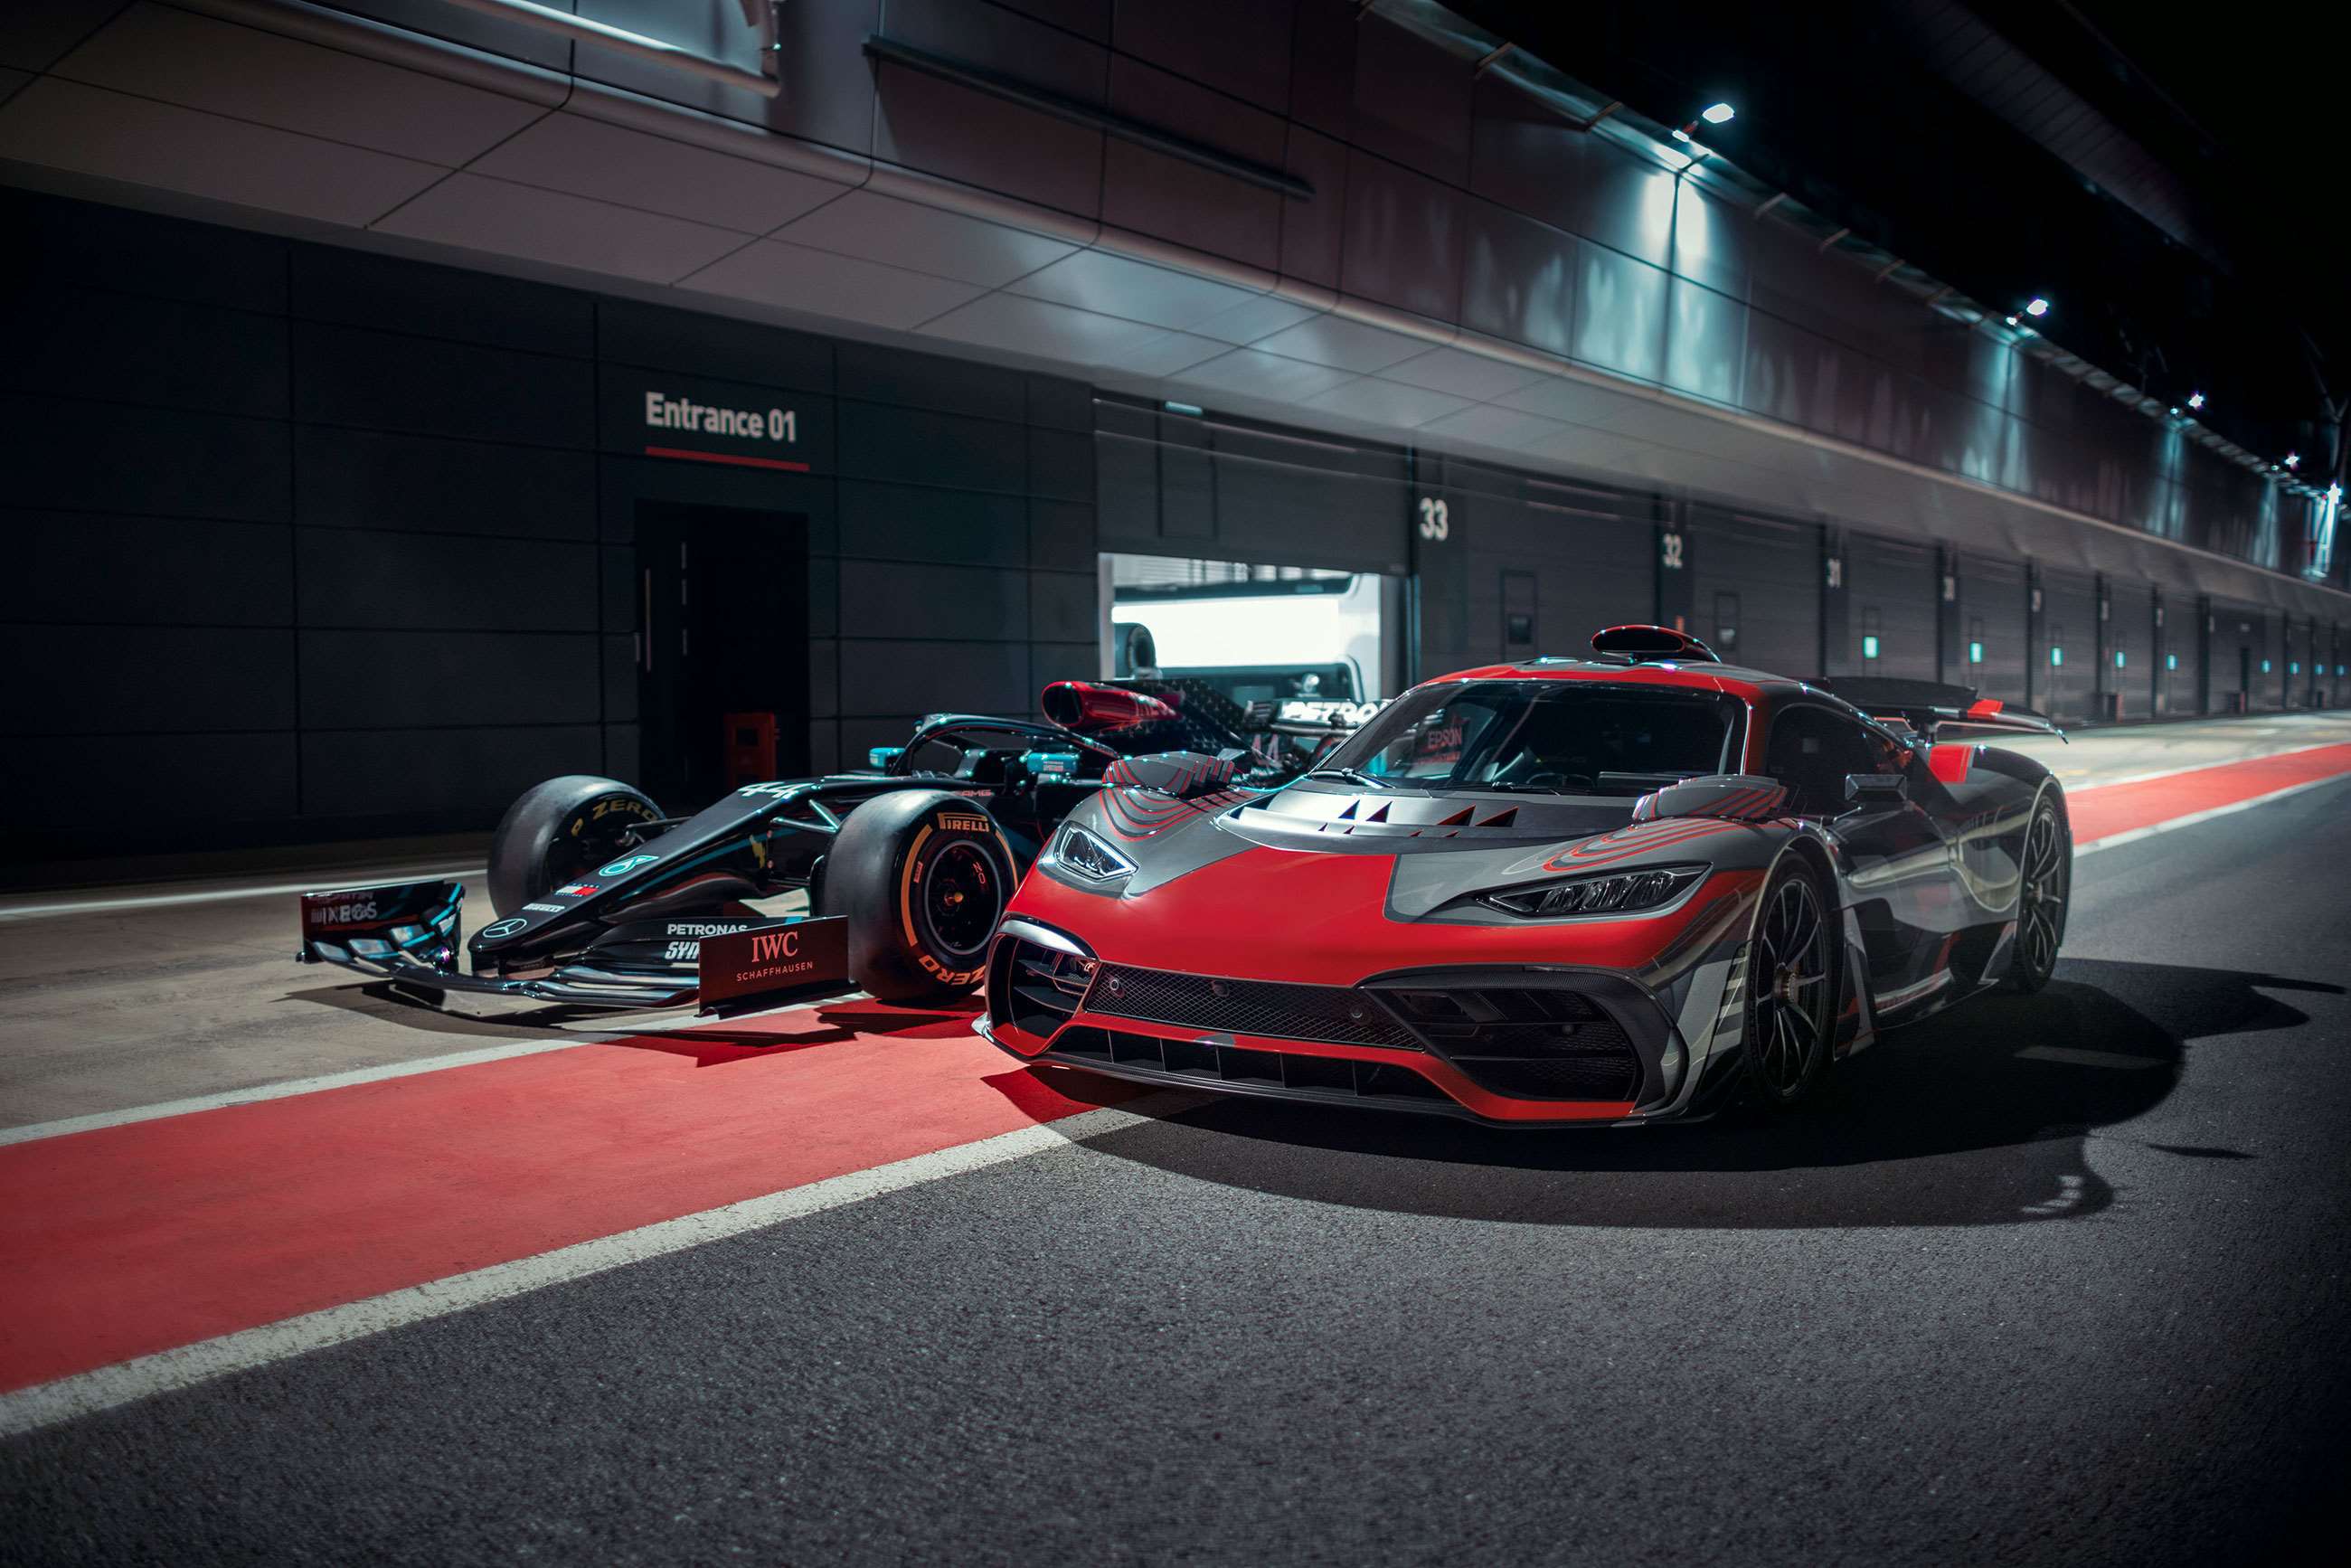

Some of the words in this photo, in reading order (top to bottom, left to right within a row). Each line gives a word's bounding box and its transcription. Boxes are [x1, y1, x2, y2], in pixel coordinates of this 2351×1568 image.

[646, 391, 764, 438] Entrance
[769, 408, 796, 442] 01
[1420, 497, 1448, 541] 33
[1663, 534, 1683, 569] 32
[737, 781, 815, 799] 44
[592, 799, 660, 822] ZERO
[937, 812, 990, 832] PIRELLI
[322, 901, 377, 926] INEOS
[751, 930, 798, 963] IWC
[736, 961, 814, 982] SCHAFFHAUSEN
